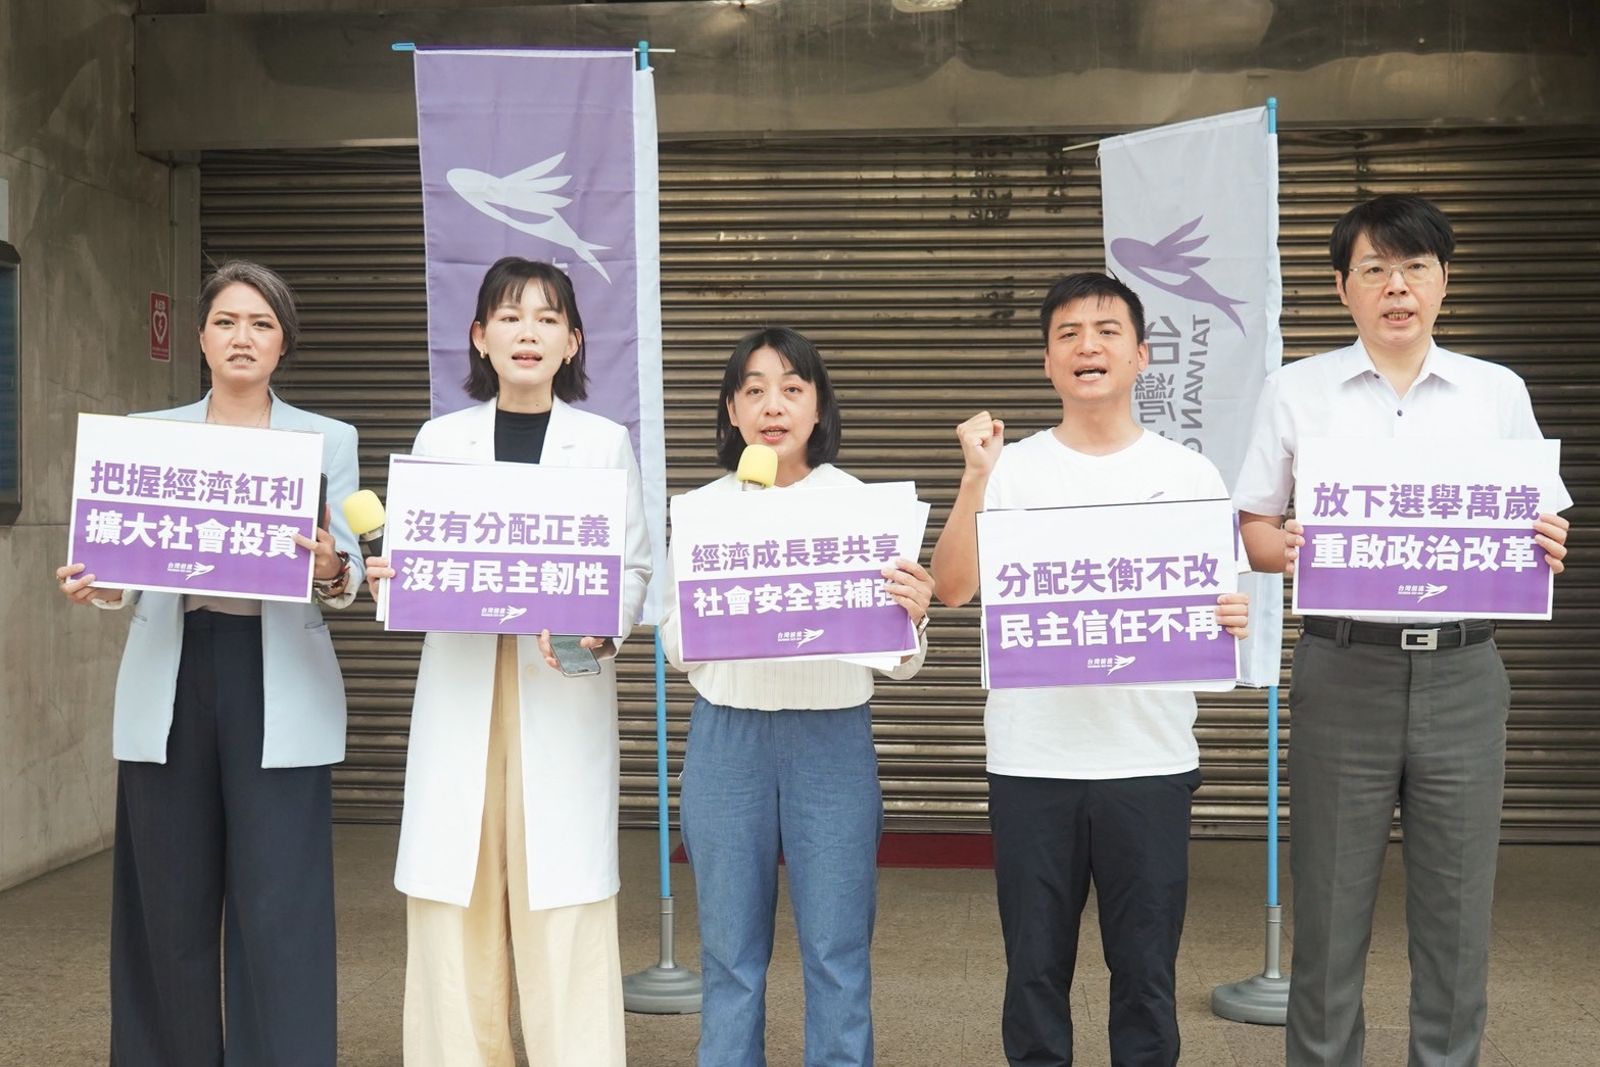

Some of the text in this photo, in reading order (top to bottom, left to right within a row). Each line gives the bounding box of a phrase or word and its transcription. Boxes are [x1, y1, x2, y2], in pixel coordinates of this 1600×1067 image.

[90, 460, 304, 510] 把握經濟紅利
[1312, 482, 1541, 521] 放下選舉萬歲
[85, 508, 301, 559] 擴大社會投資
[404, 509, 610, 548] 沒有分配正義
[691, 533, 901, 573] 經濟成長要共享
[1311, 533, 1538, 572] 重啟政治改革
[401, 556, 609, 596] 沒有民主韌性
[996, 552, 1220, 598] 分配失衡不改
[1000, 605, 1223, 650] 民主信任不再
